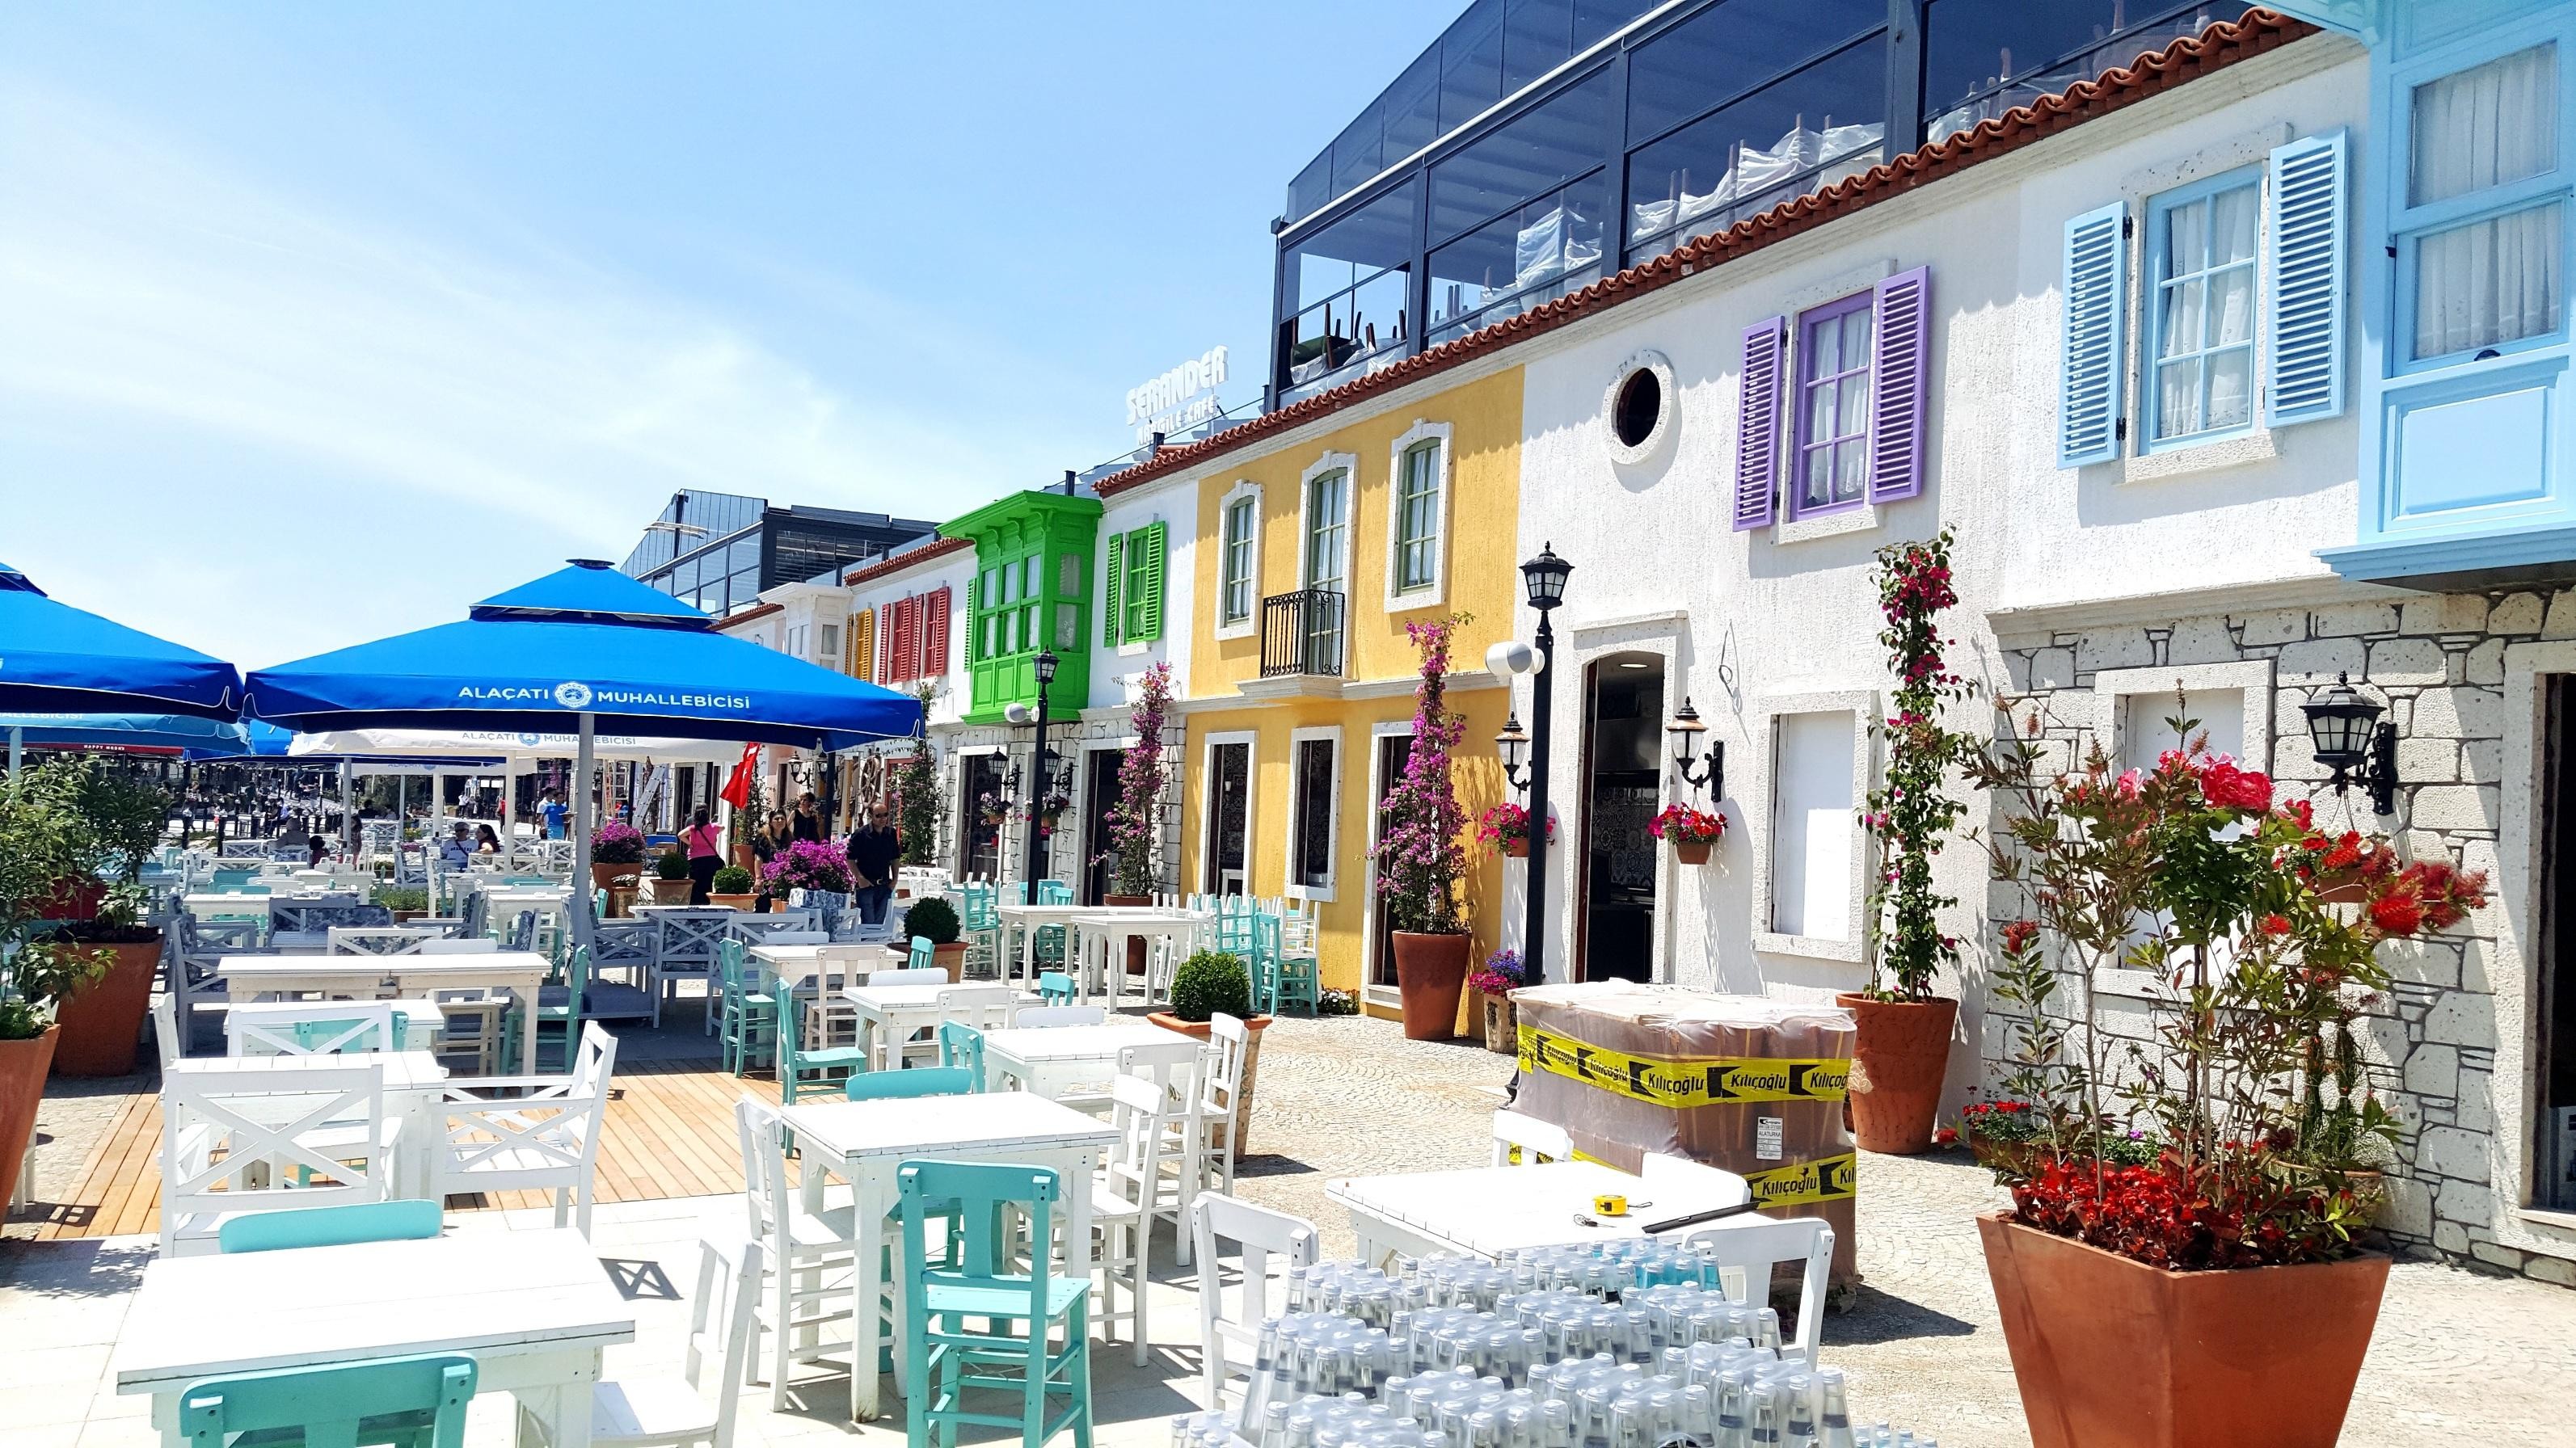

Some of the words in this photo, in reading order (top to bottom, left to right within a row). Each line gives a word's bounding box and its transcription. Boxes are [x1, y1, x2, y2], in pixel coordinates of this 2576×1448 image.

[1126, 345, 1229, 426] SERANDER
[459, 687, 549, 700] ALAÇATI
[598, 692, 749, 708] MUHALLEBİCİSİ
[462, 732, 515, 741] ALAÇATI
[1648, 1072, 1704, 1095] Kılıçoğlu
[1731, 1072, 1787, 1090] Kılıçoğlu
[1810, 1071, 1849, 1091] Kılıçoğ
[1762, 1176, 1817, 1196] Kılıçoğlu
